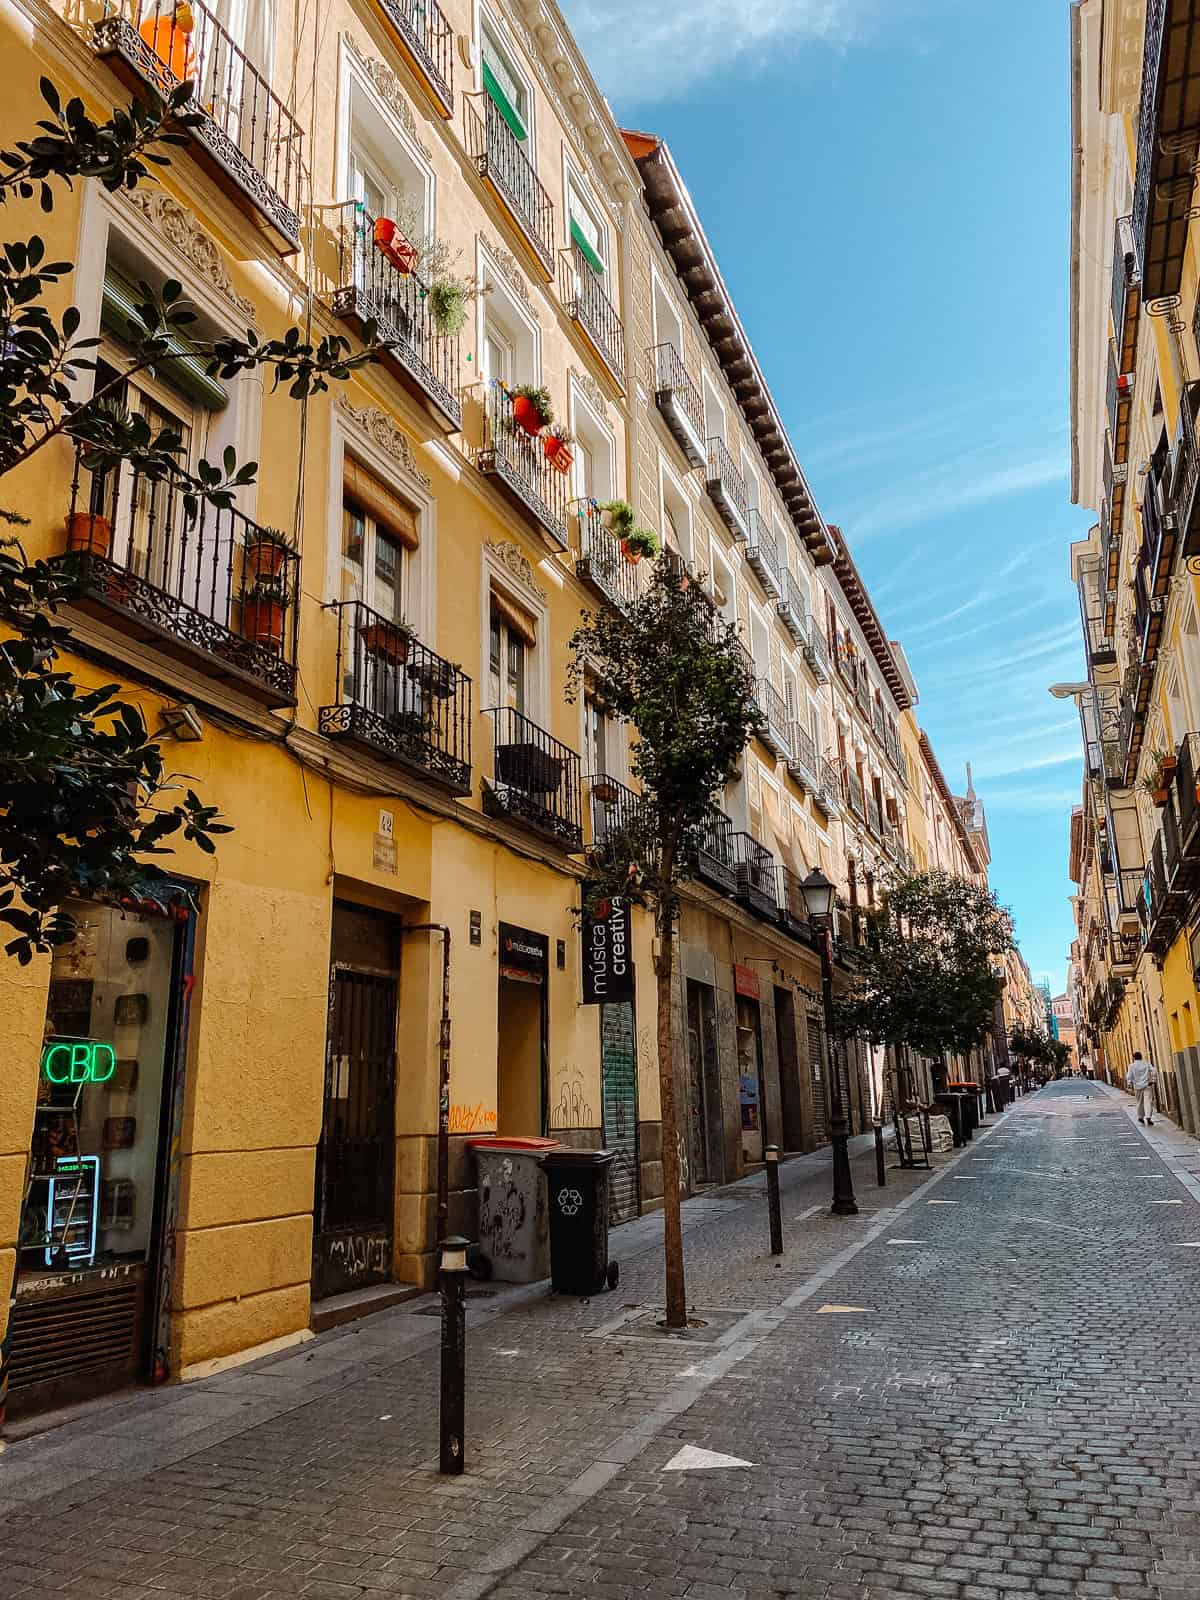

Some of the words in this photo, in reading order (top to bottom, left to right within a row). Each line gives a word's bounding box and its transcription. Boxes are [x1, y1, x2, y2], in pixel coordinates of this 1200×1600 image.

[588, 924, 608, 995] música
[608, 895, 626, 975] creativa
[45, 1044, 116, 1083] CBD
